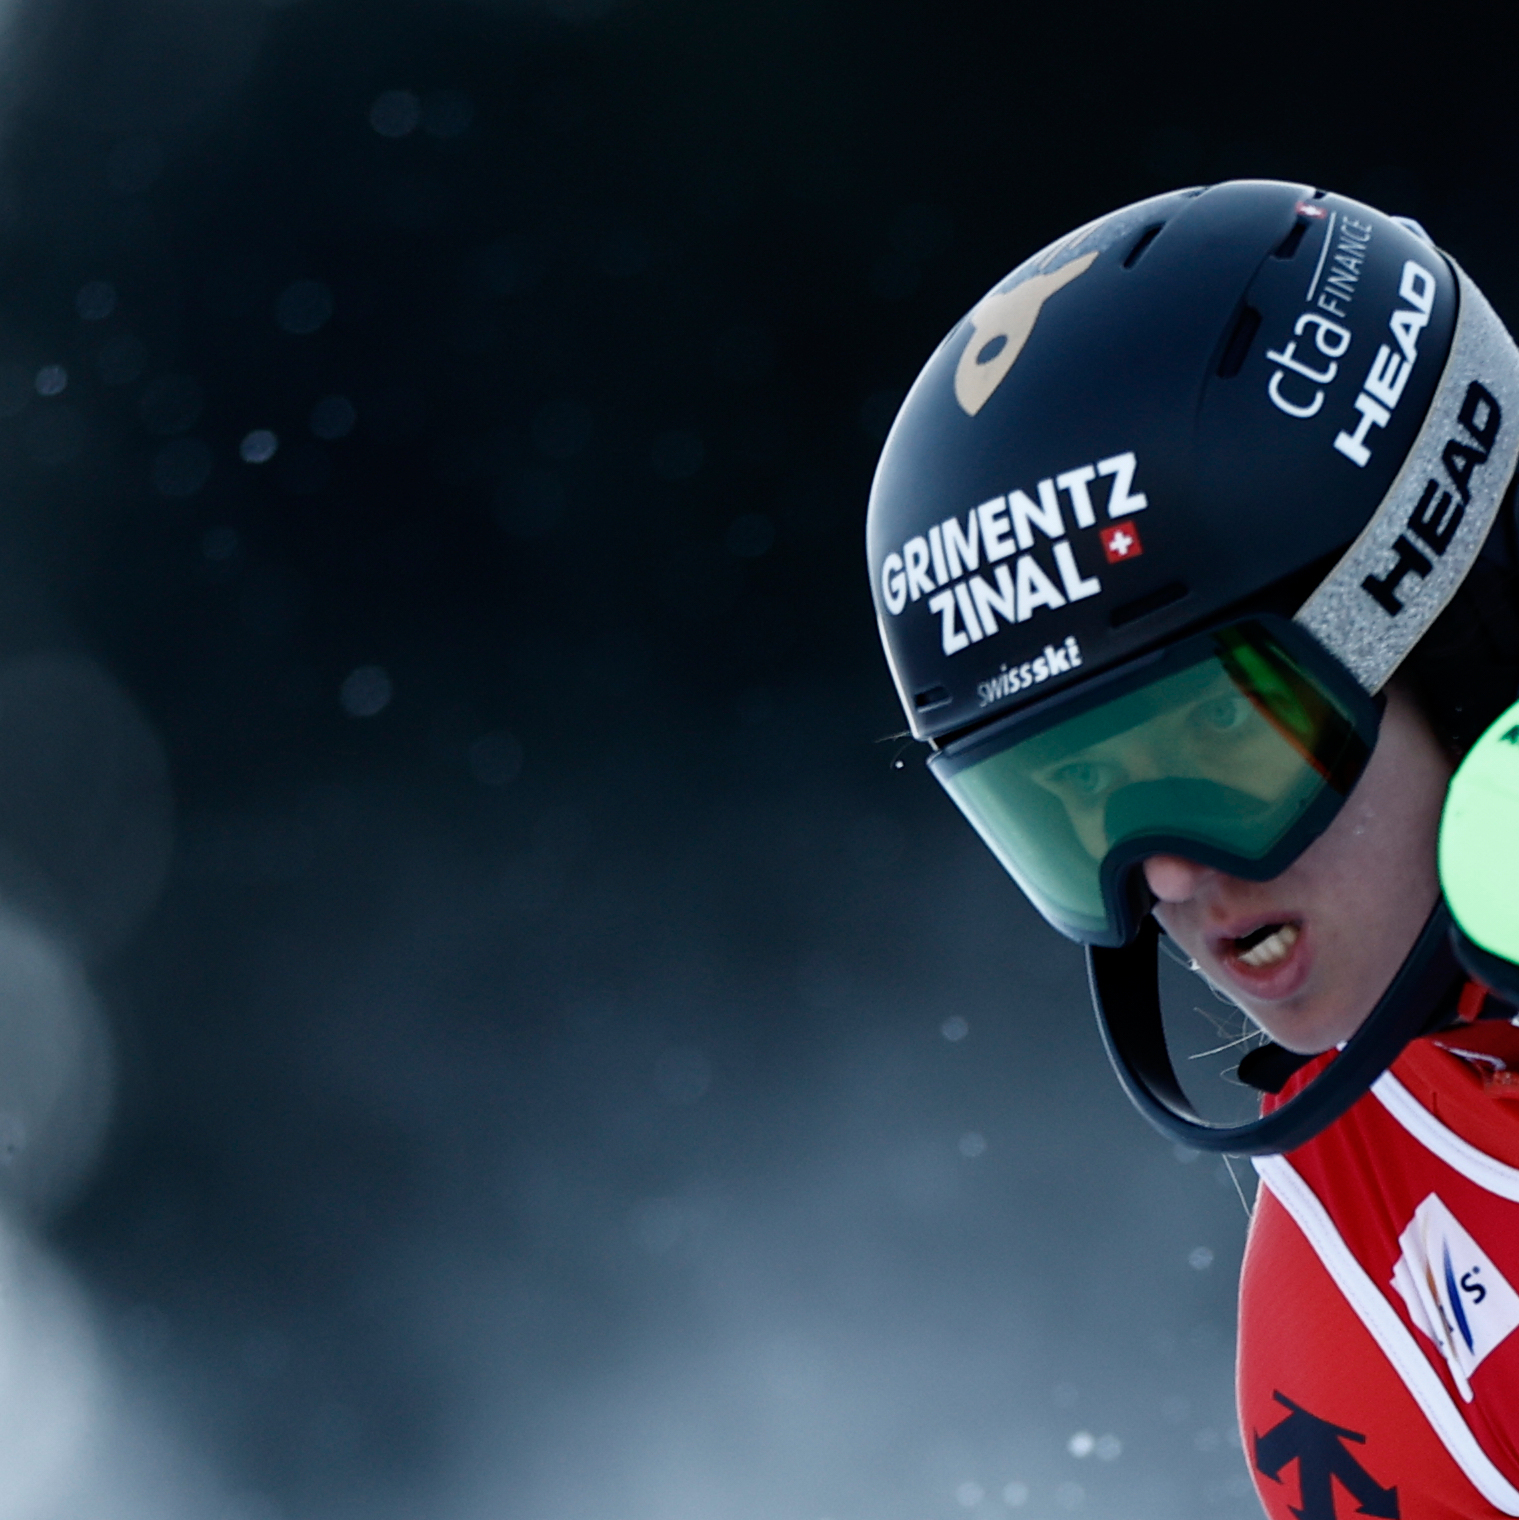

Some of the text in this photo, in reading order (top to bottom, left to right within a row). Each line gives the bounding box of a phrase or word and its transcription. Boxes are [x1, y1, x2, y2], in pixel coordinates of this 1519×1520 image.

[1333, 259, 1436, 468] HEAD
[881, 451, 1148, 615] GRIMENTZ
[1360, 379, 1502, 618] HEAD
[928, 542, 1101, 656] ZINAL
